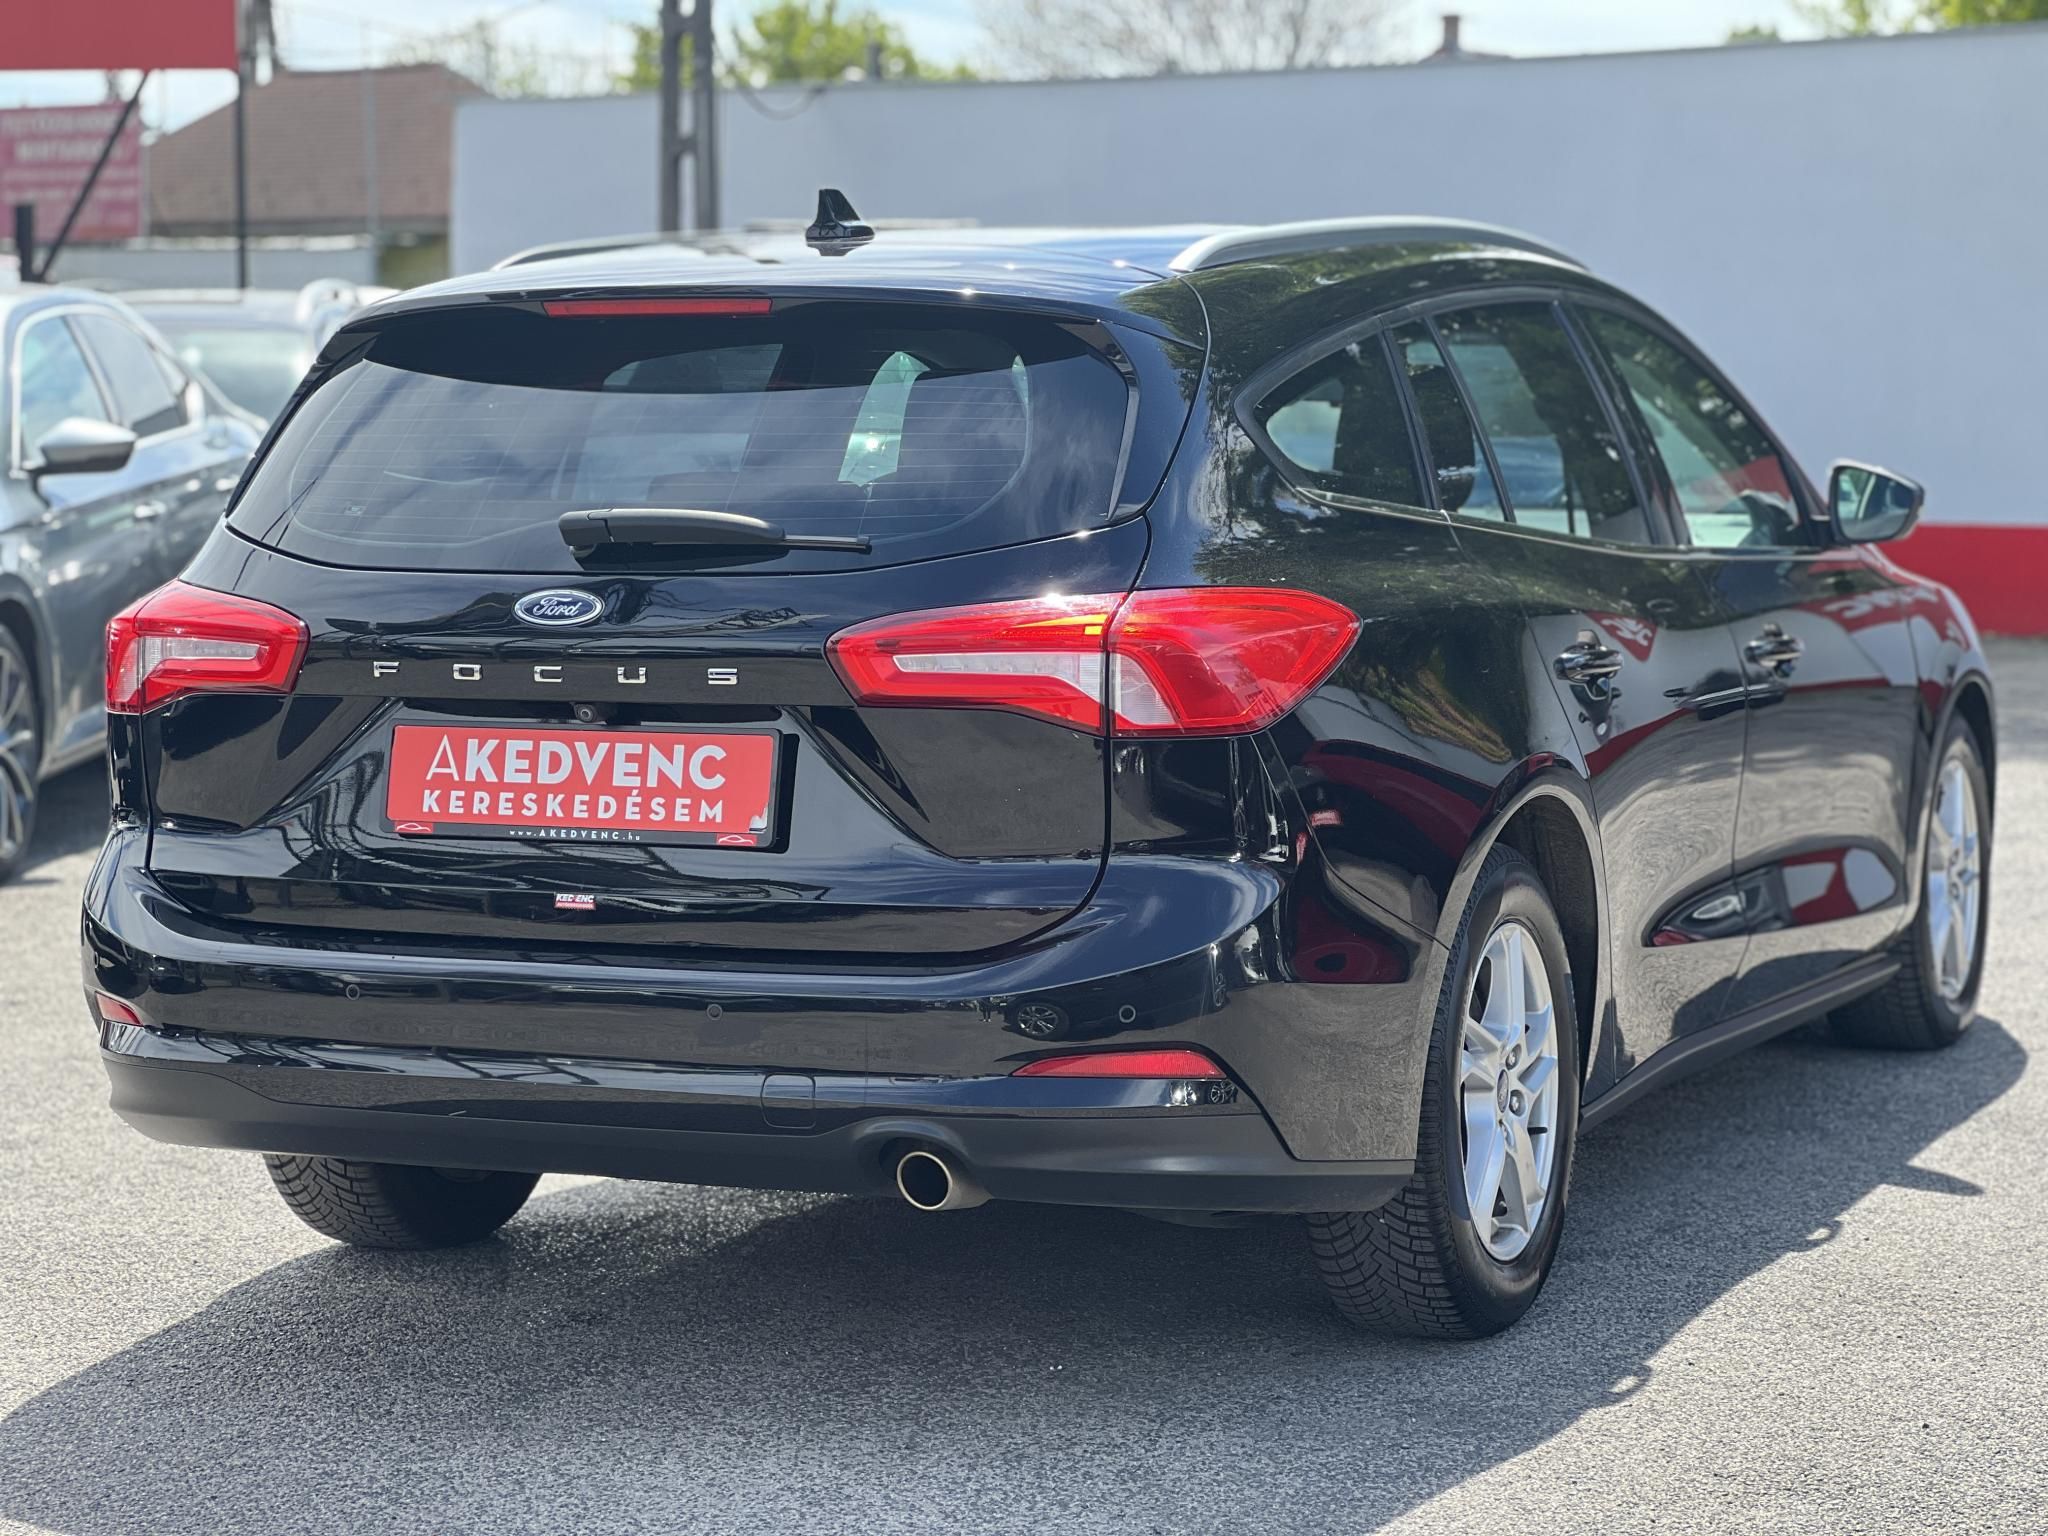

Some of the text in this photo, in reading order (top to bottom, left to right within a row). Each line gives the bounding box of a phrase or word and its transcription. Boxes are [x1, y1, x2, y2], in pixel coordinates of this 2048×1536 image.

[532, 596, 582, 617] Ford
[373, 661, 738, 685] FOCUS
[422, 789, 723, 823] KERESKEDÉSEM
[509, 829, 640, 841] www.AKEDVENC.hu
